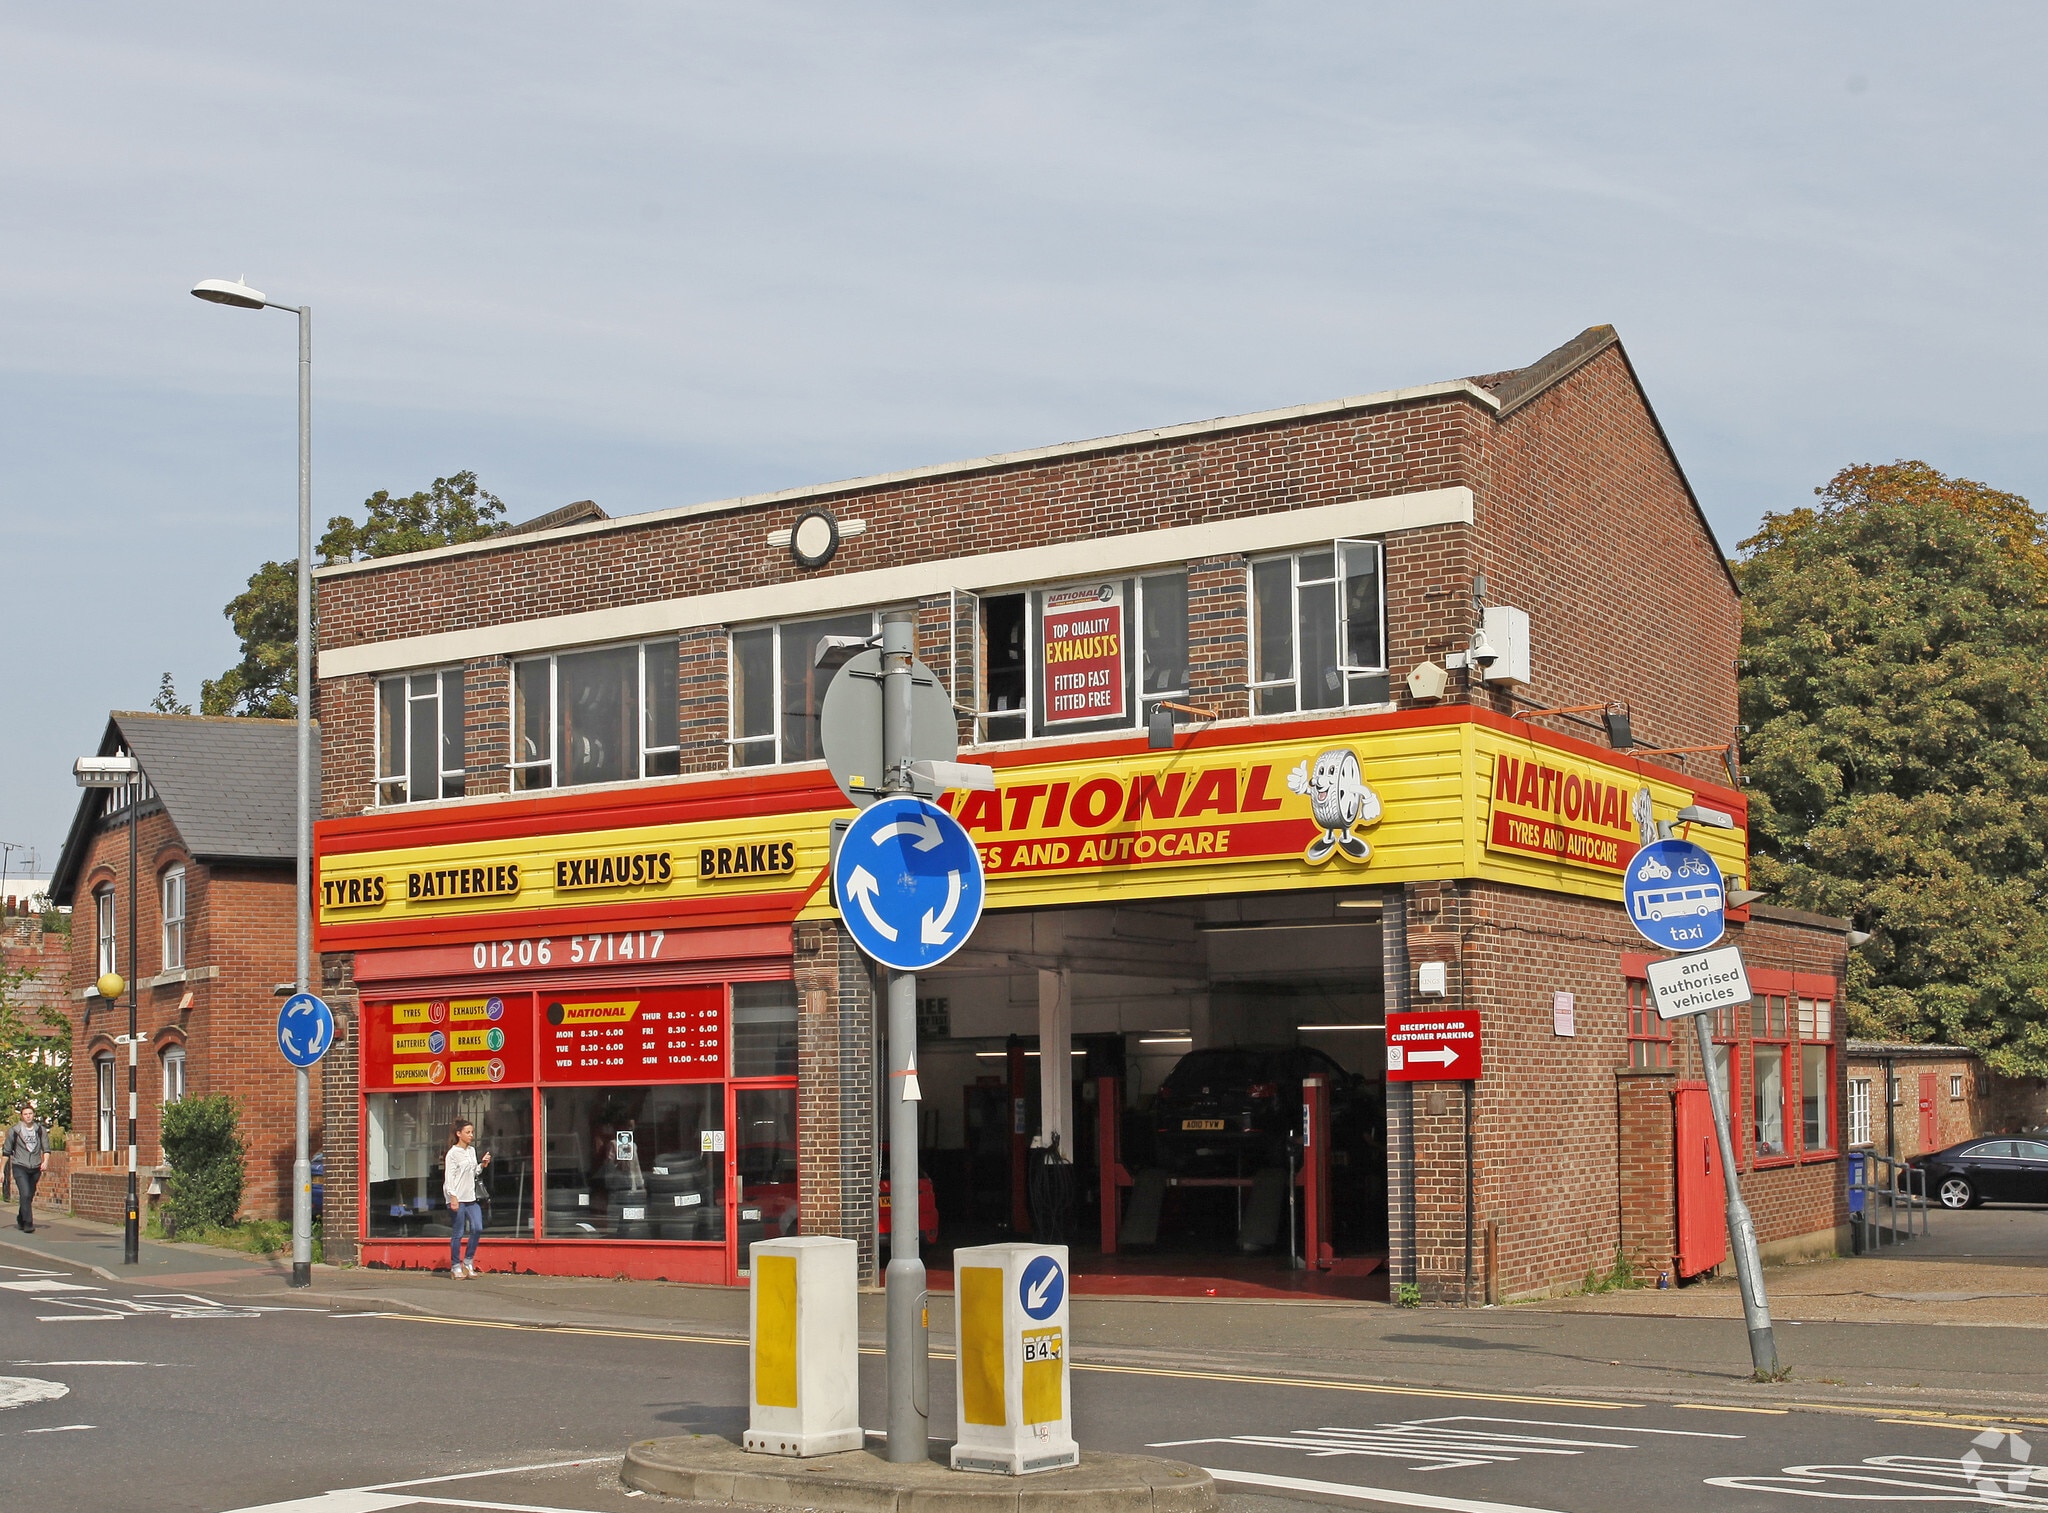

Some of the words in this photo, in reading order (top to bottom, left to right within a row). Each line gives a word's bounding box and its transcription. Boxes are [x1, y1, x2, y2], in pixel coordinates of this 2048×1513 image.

[1048, 590, 1100, 603] NATIONAL
[1053, 624, 1069, 639] TOP
[1071, 618, 1110, 636] QUALITY
[1046, 634, 1118, 664] EXHAUSTS
[1054, 673, 1086, 691] FITTED
[1088, 670, 1110, 686] FAST
[1054, 693, 1086, 712] FITTED
[1088, 690, 1111, 706] FREE
[936, 765, 1283, 833] ATIONAL
[1494, 754, 1633, 833] NATIONAL
[1010, 842, 1070, 868] AND
[1078, 830, 1229, 862] AUTOCARE
[1508, 820, 1540, 847] TYRES
[1543, 826, 1566, 852] AND
[1566, 834, 1618, 864] AUTOCARE
[700, 841, 795, 876] BRAKES
[557, 851, 672, 887] EXHAUSTS
[408, 864, 520, 898] BATTERIES
[323, 875, 385, 906] TYRES
[1670, 924, 1703, 941] taxi
[473, 939, 552, 969] 01206
[570, 930, 666, 963] 571417
[1681, 959, 1709, 975] and
[1659, 968, 1739, 996] authorised
[1673, 988, 1734, 1009] vehicles
[403, 1009, 421, 1017] TYRES
[454, 1006, 485, 1016] EXHAUSTS
[567, 1007, 626, 1018] NATIONAL
[668, 1026, 686, 1034] 8.30
[699, 1025, 718, 1033] 6.00
[1400, 1023, 1444, 1032] RECEPTION
[1446, 1022, 1465, 1030] AND
[396, 1039, 426, 1048] BATTERIES
[458, 1036, 481, 1045] BRAKES
[1391, 1033, 1434, 1041] CUSTOMER
[1436, 1031, 1475, 1039] PARKING
[580, 1044, 598, 1052] 8.30
[605, 1043, 624, 1051] 6.00
[642, 1042, 655, 1050] SAT
[668, 1041, 686, 1049] 8.30
[668, 1055, 692, 1063] 10.00
[699, 1054, 718, 1062] 4.00
[395, 1070, 428, 1079] SUSPENSION
[456, 1067, 486, 1076] STEERING
